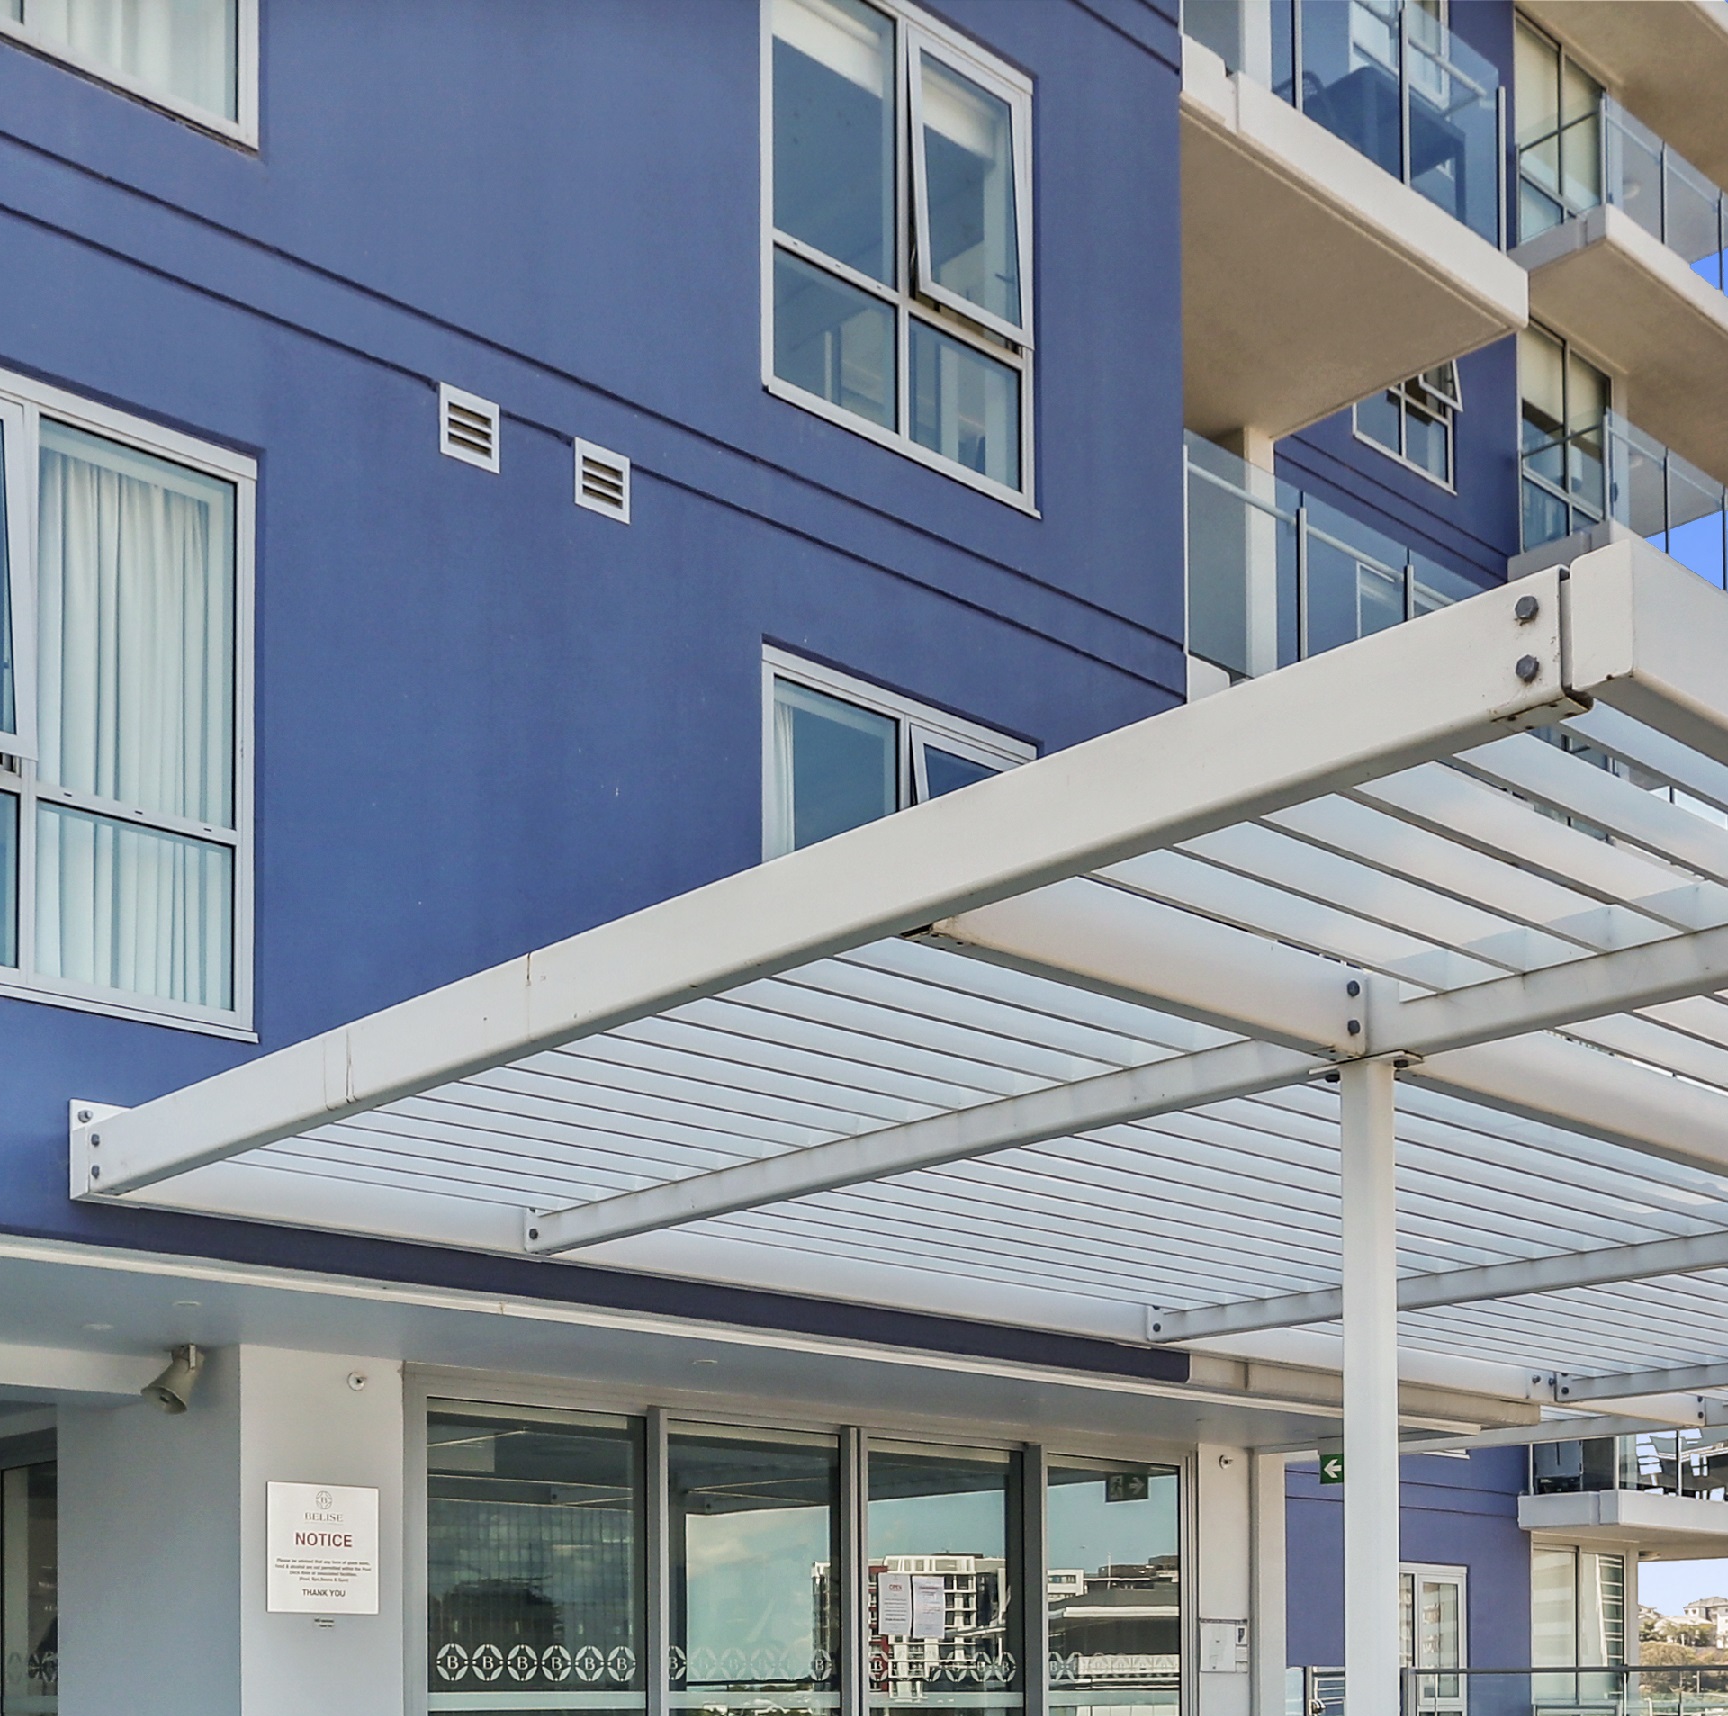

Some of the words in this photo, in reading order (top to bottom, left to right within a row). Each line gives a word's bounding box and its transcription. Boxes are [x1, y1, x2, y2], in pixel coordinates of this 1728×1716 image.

[304, 1512, 344, 1522] BELISE
[295, 1532, 353, 1548] NOTICE
[302, 1588, 328, 1597] THANK
[329, 1589, 346, 1598] YOU
[447, 1655, 459, 1670] B
[482, 1656, 494, 1670] B
[517, 1656, 528, 1670] B
[551, 1657, 562, 1671] B
[584, 1657, 595, 1670] B
[616, 1657, 628, 1671] B
